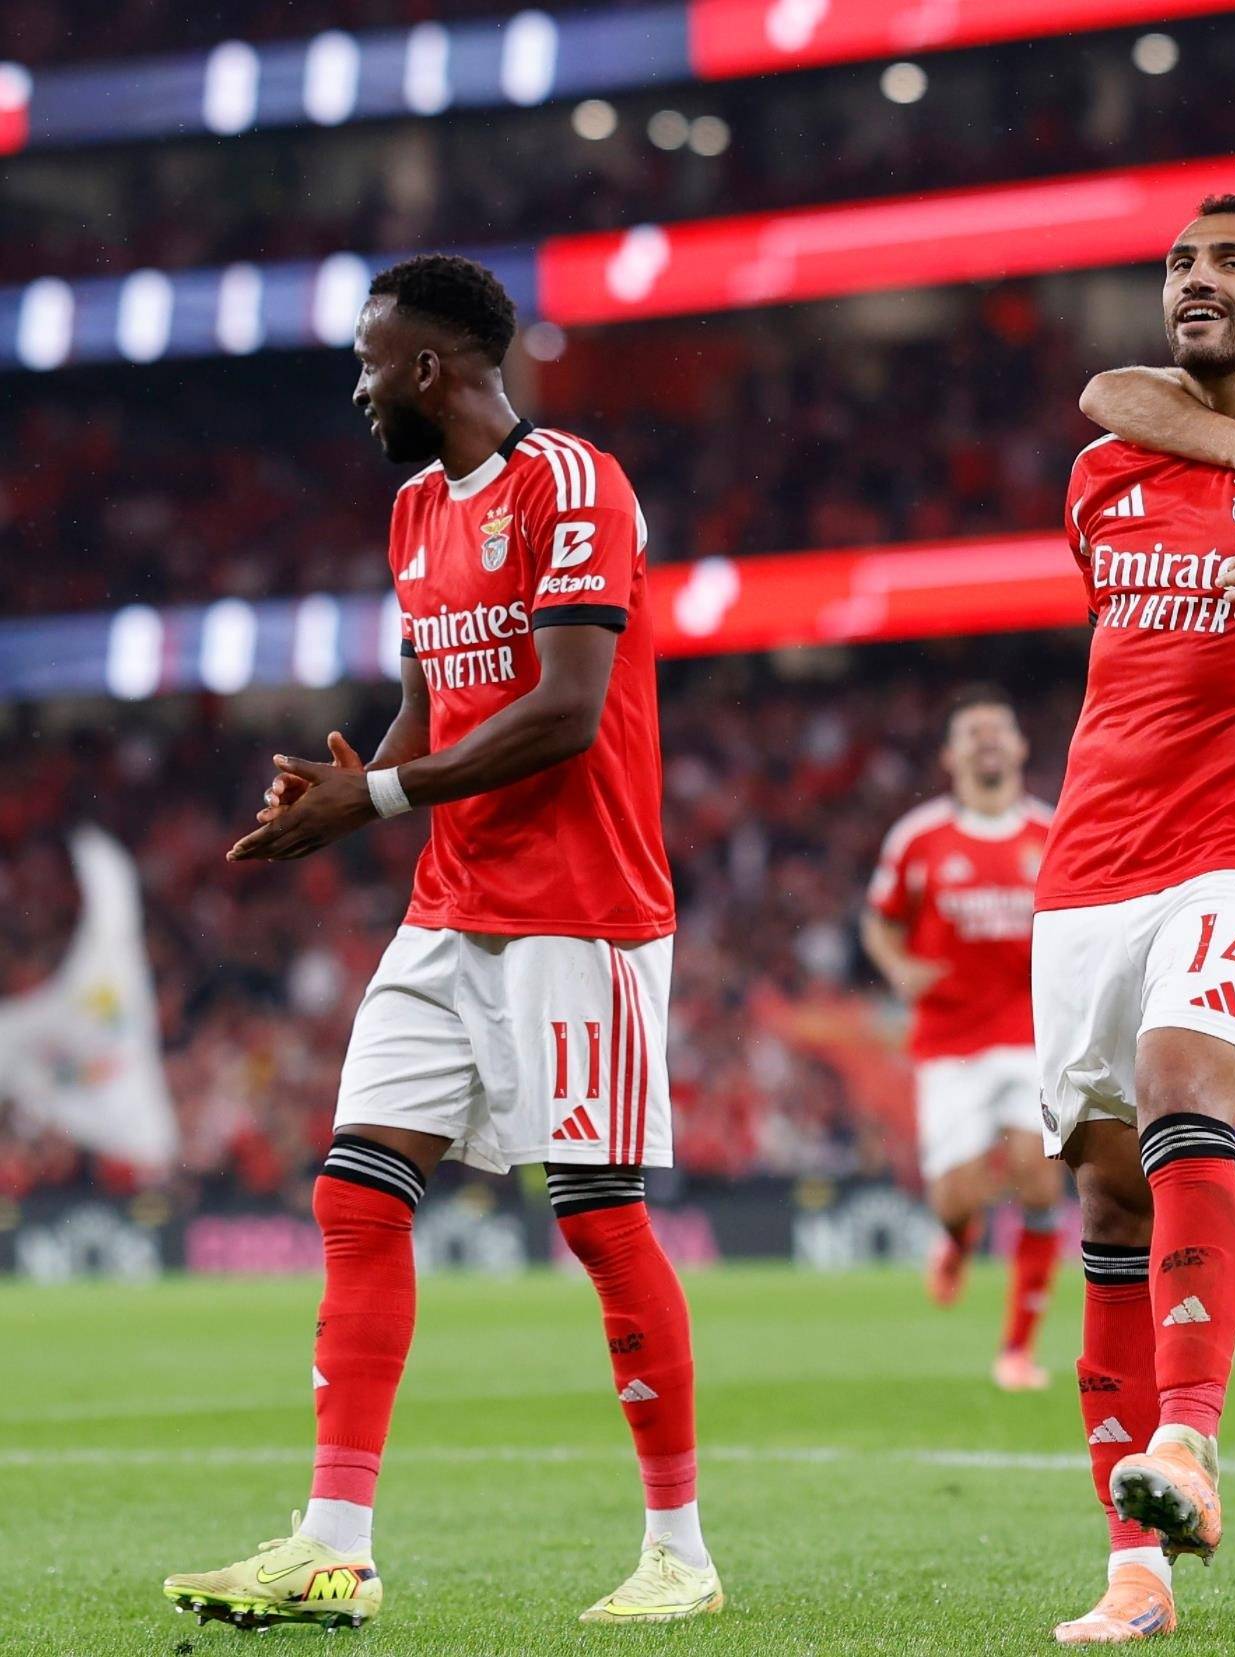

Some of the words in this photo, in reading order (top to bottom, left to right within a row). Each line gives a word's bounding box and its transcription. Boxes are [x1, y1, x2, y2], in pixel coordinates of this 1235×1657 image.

[537, 575, 606, 595] Betano
[1094, 543, 1235, 592] Emirat
[1138, 594, 1231, 634] BETTER
[444, 645, 516, 690] BETTER
[551, 1021, 601, 1099] 11
